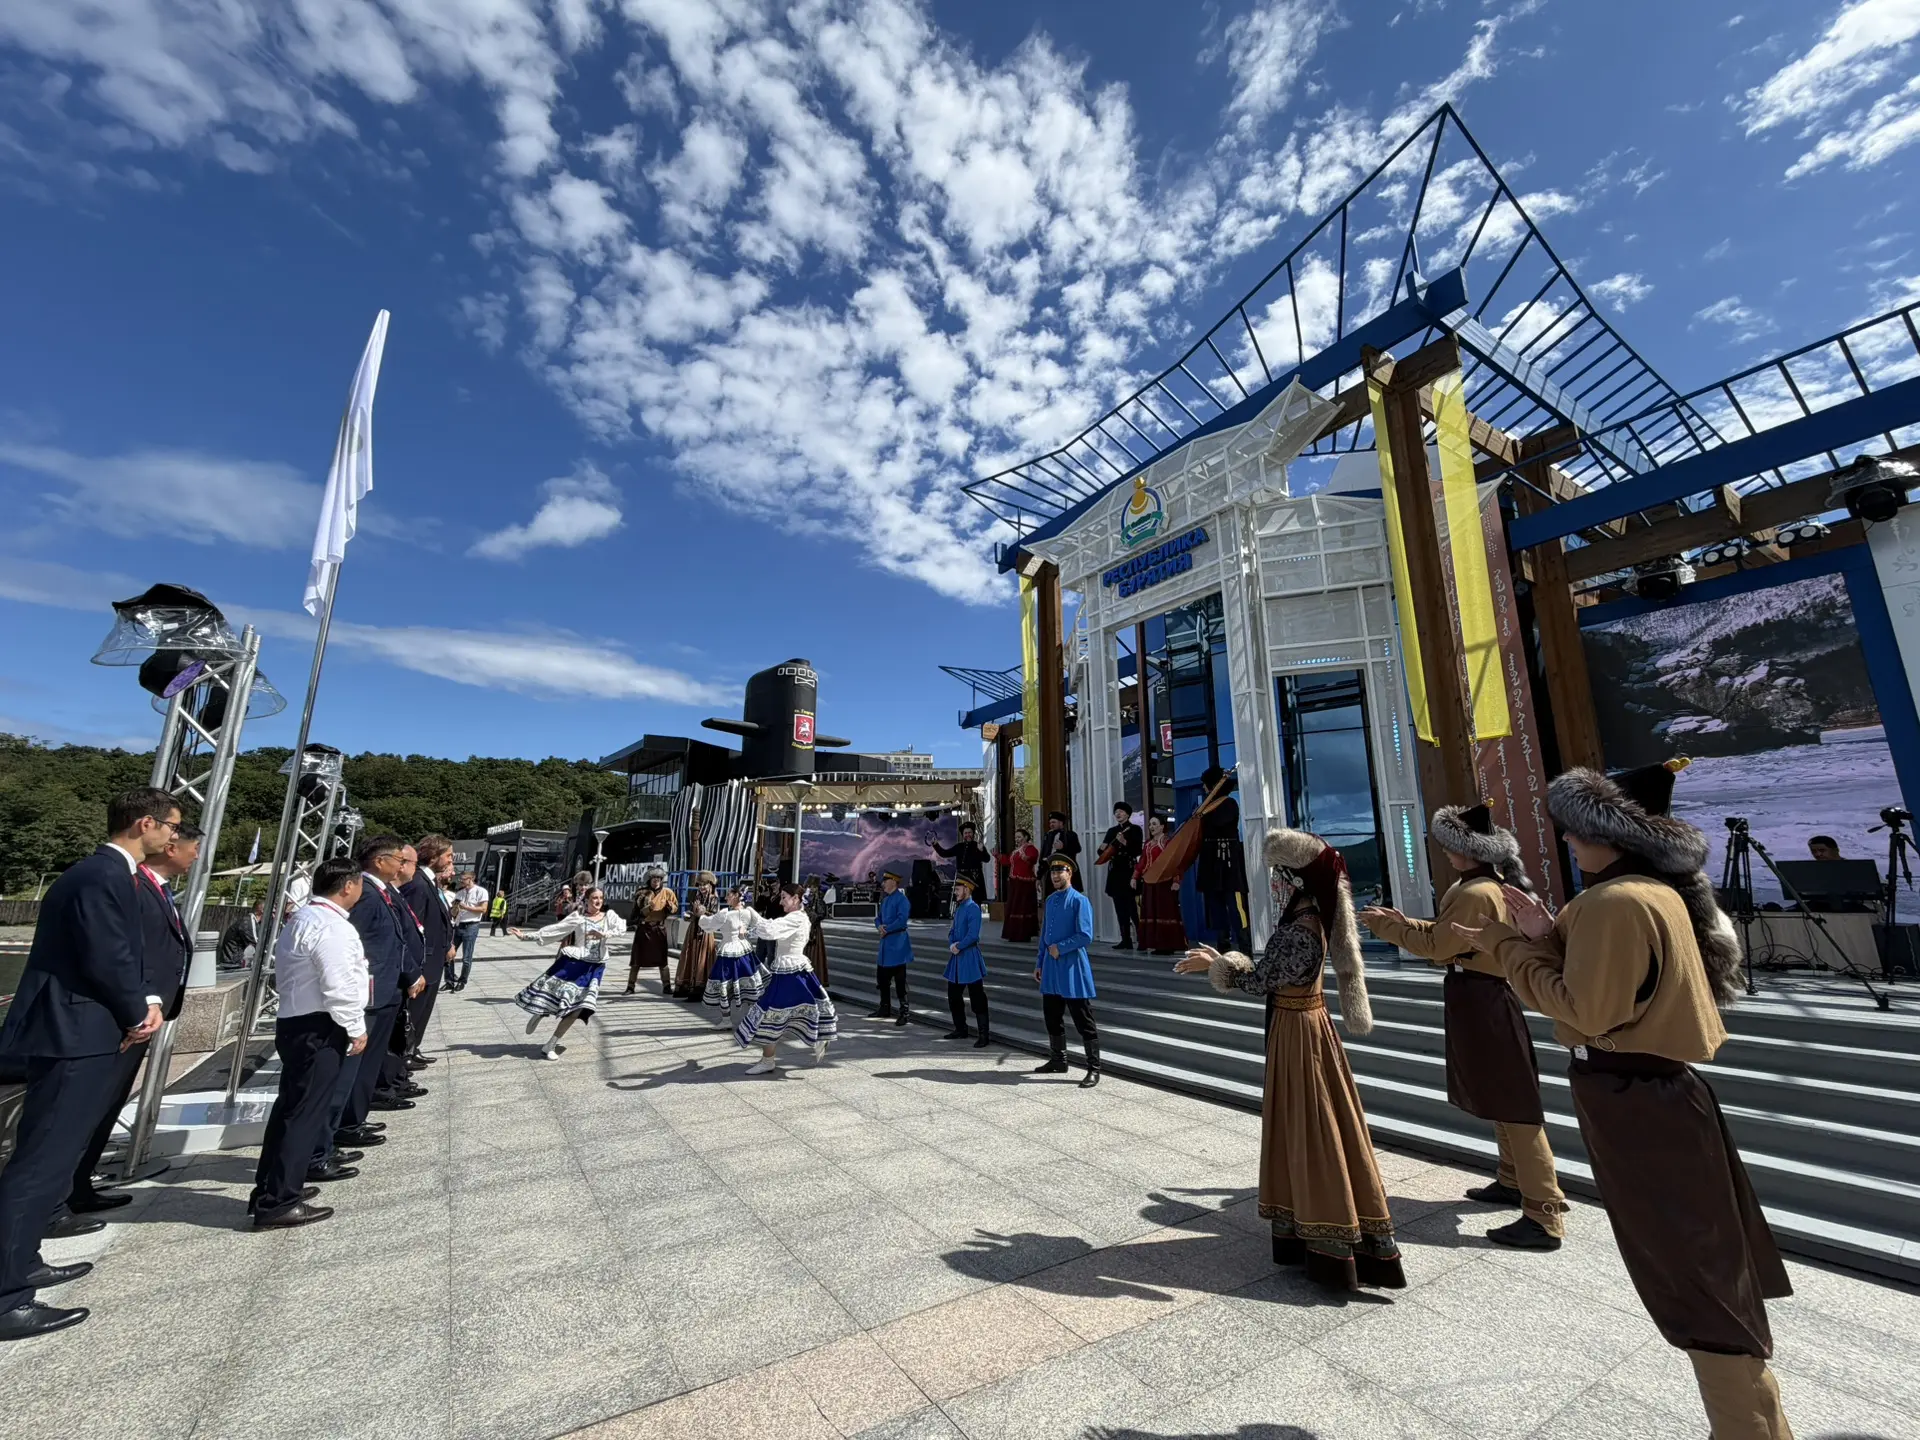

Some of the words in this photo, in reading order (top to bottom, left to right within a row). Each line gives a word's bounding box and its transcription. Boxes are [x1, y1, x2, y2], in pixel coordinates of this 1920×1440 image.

[1103, 527, 1210, 588] РЕСПУБЛИКА
[1118, 553, 1193, 598] БУРЯТИЯ
[604, 885, 637, 900] KAMCH
